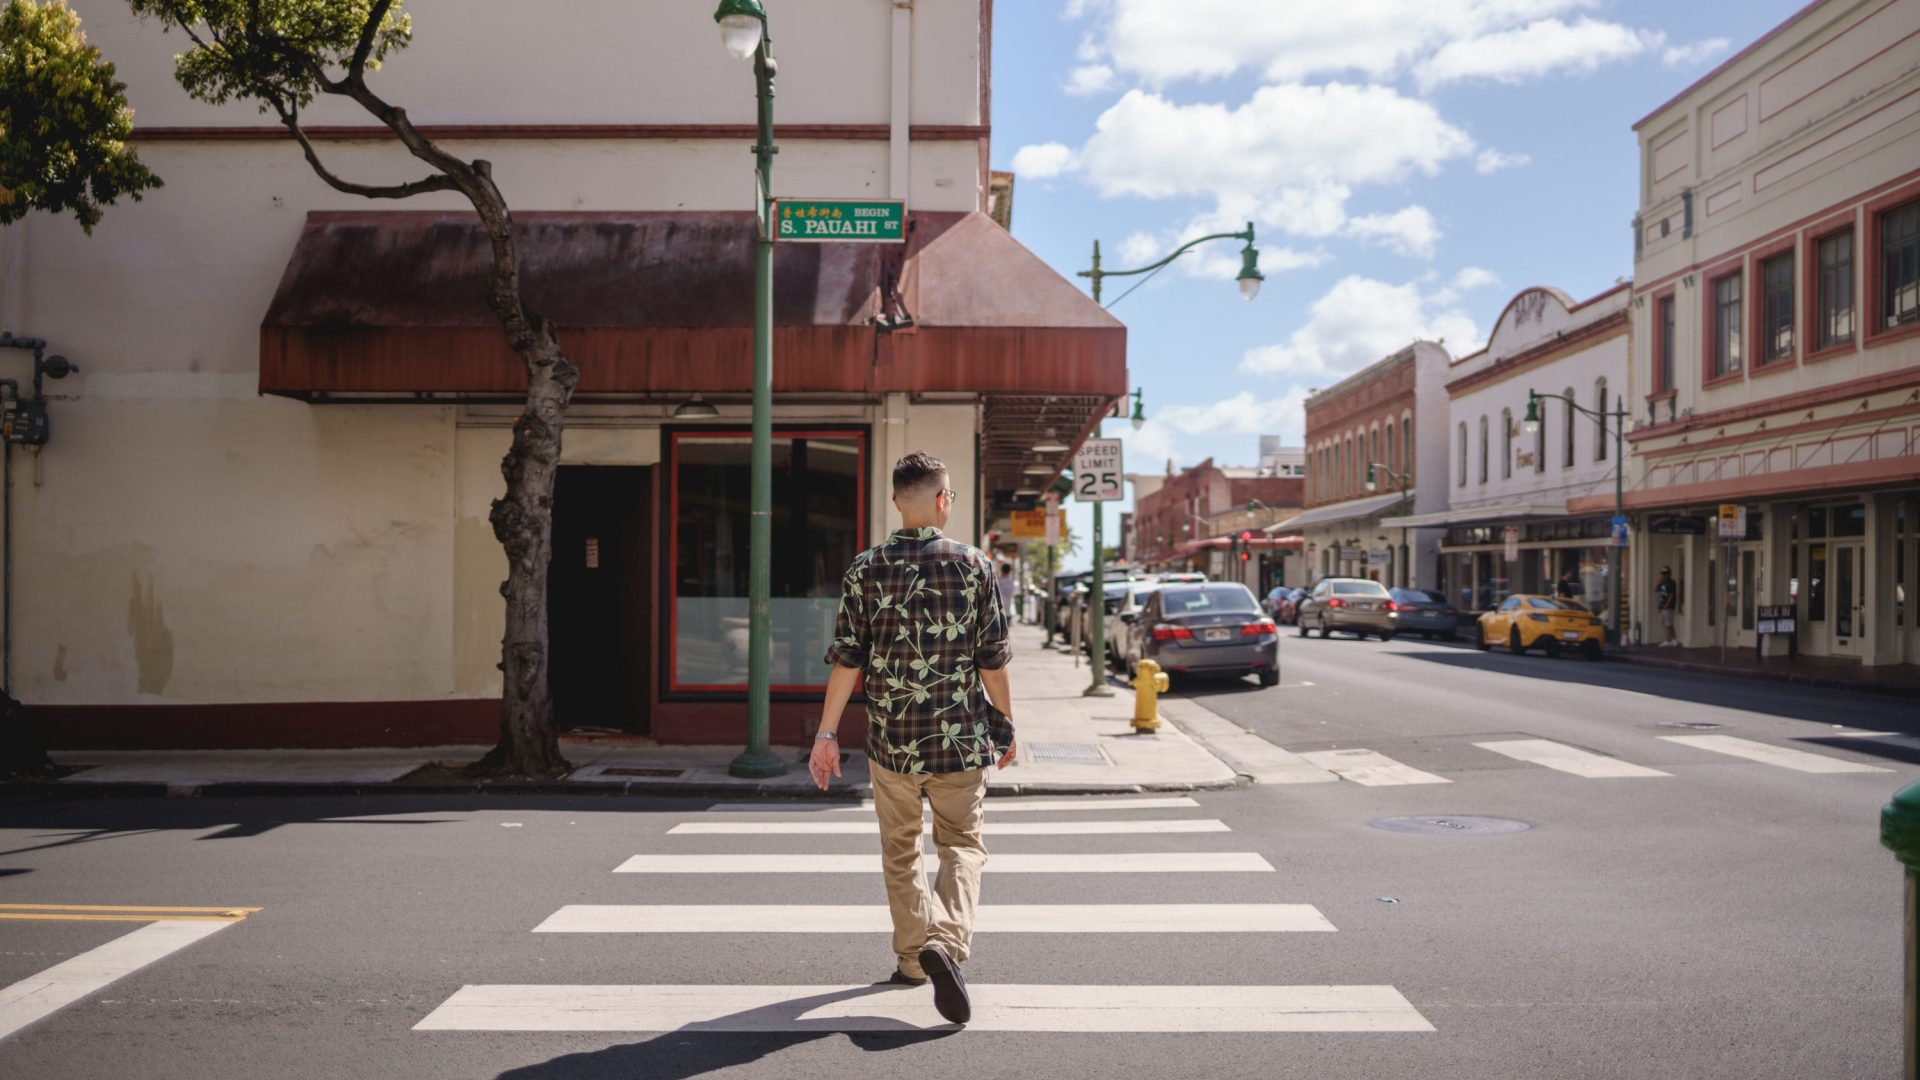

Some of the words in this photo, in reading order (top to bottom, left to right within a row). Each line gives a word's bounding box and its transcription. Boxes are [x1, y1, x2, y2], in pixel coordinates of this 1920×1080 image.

[854, 208, 889, 217] BEGIN
[781, 220, 797, 234] S.
[805, 220, 877, 234] PAUAHI
[884, 221, 899, 230] ST
[1079, 446, 1118, 456] SPEED
[1081, 459, 1114, 469] LIMIT
[1080, 473, 1118, 496] 25
